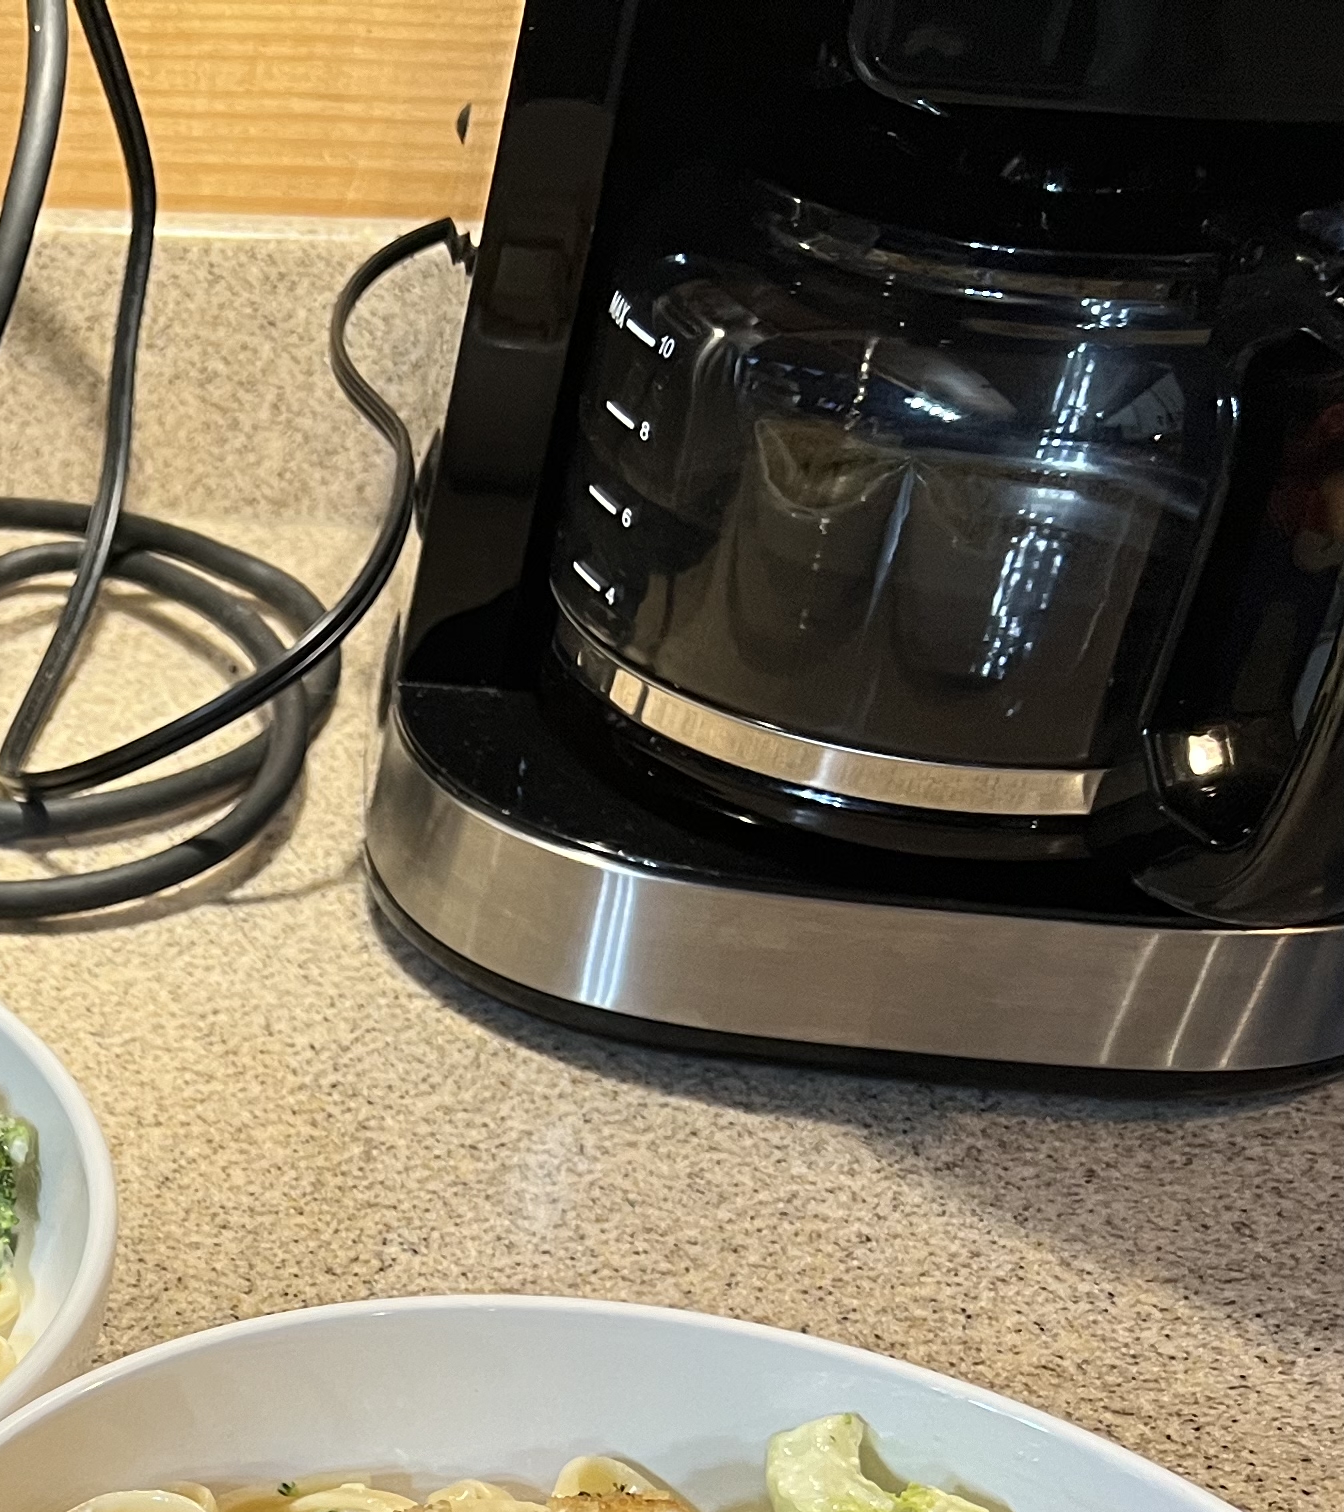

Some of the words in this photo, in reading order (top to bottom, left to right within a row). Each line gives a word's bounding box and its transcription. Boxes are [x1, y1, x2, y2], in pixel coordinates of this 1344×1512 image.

[658, 334, 676, 359] 10
[639, 421, 650, 441] 8
[621, 507, 632, 528] 6
[604, 586, 615, 605] 4
